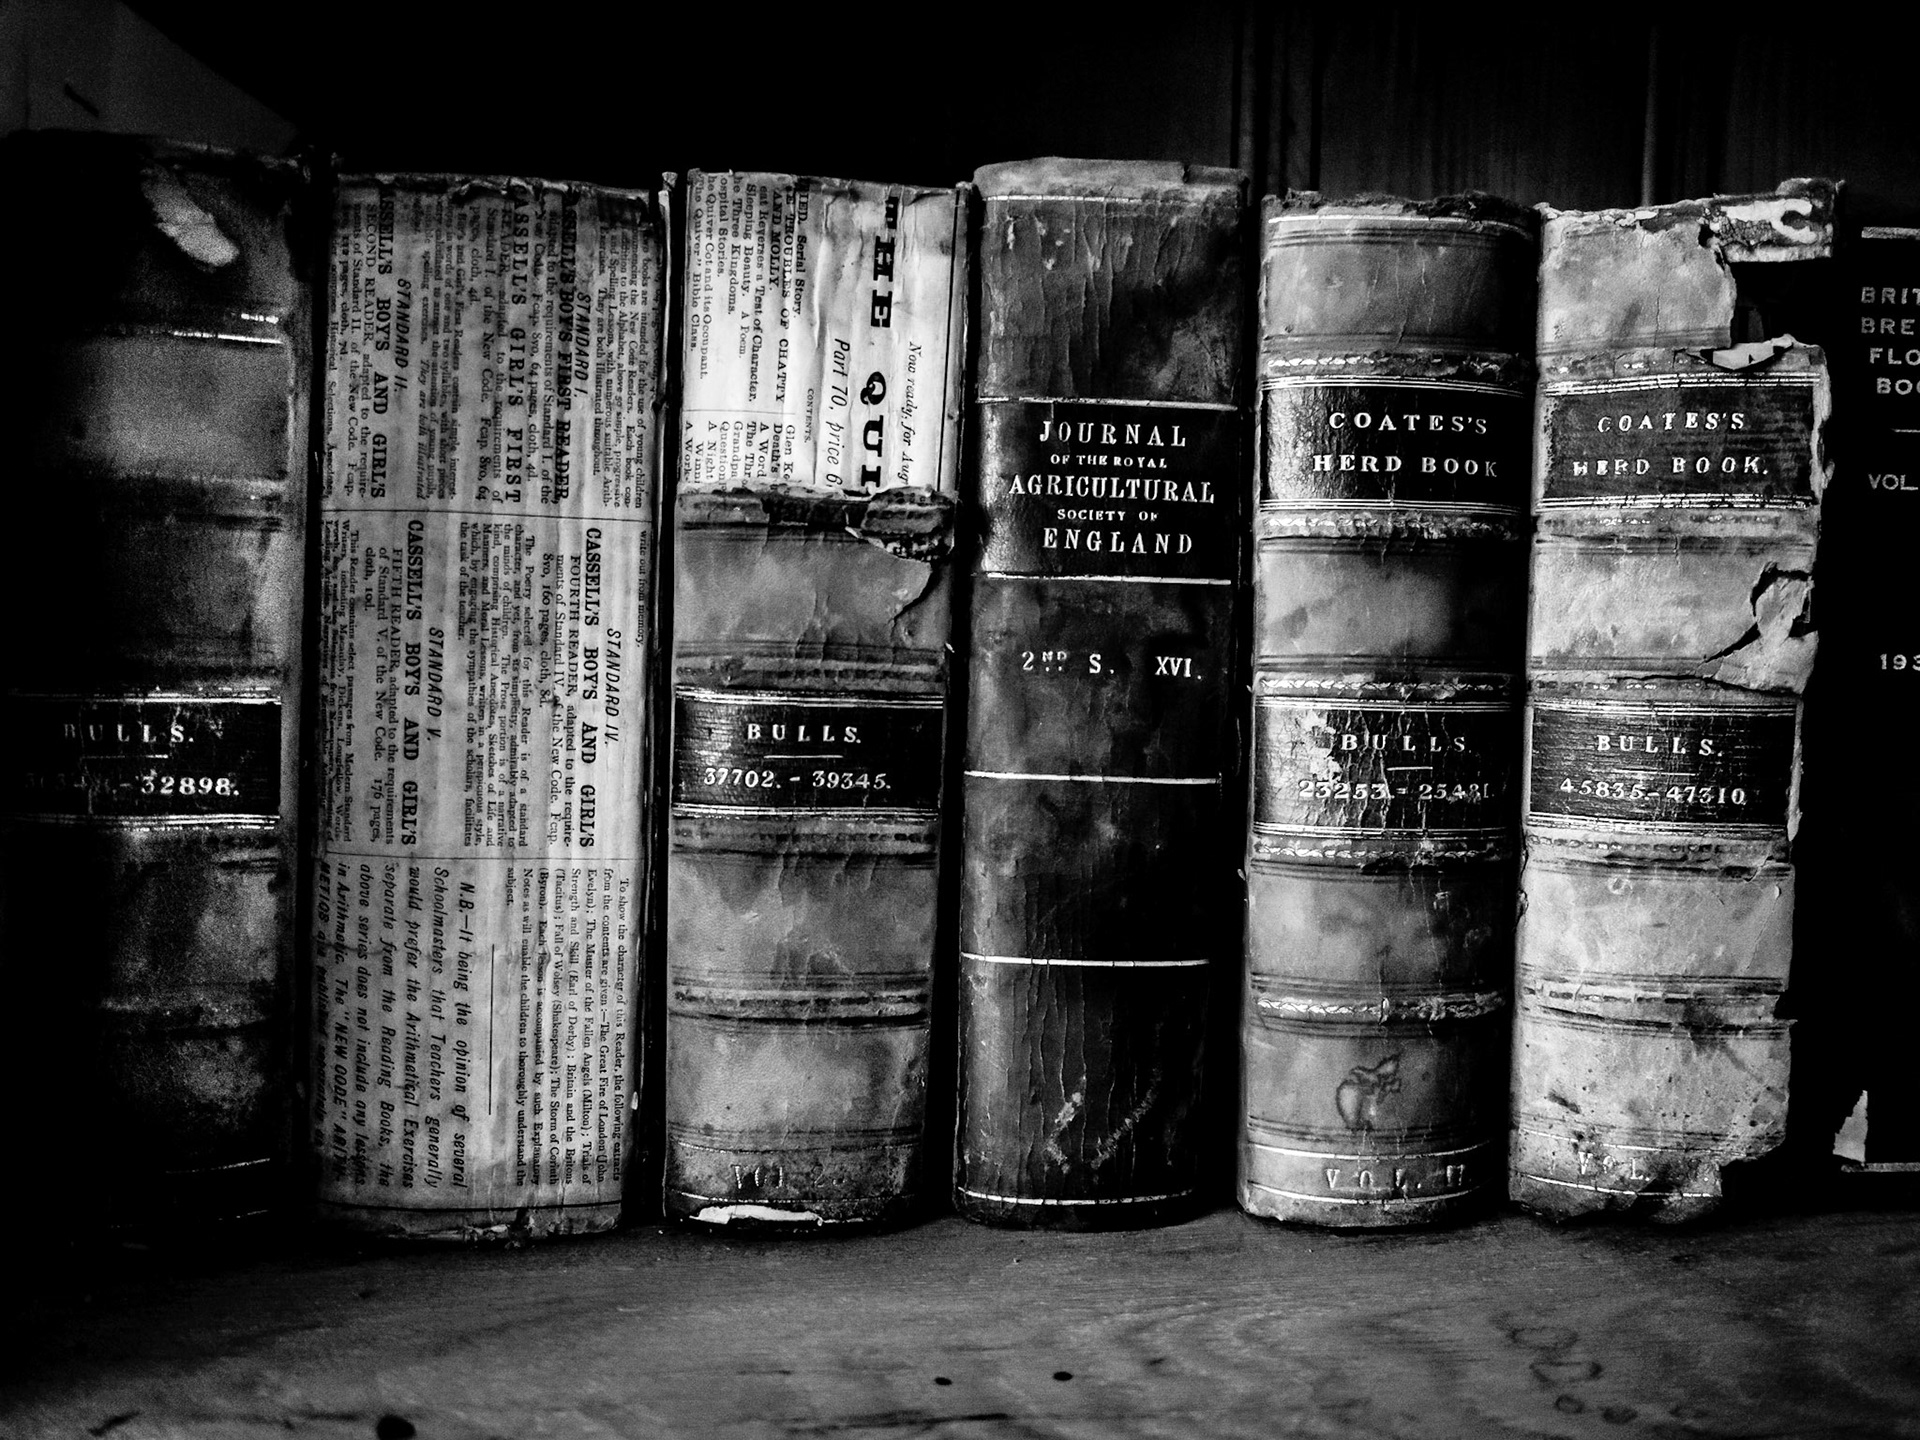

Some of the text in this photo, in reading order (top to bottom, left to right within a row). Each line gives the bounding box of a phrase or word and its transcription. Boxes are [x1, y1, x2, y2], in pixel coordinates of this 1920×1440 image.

[705, 194, 716, 240] Quiver
[732, 199, 742, 238] Three
[769, 191, 782, 291] AND MOLLY.
[704, 243, 713, 264] Cot
[717, 228, 728, 277] Stories.
[739, 184, 756, 358] Sleeping Beauty. A Poem.
[781, 213, 795, 298] TROUBLES
[795, 235, 807, 273] Serial
[871, 197, 899, 328] THE
[691, 272, 702, 307] Bible
[703, 268, 713, 292] and
[703, 296, 713, 312] its
[728, 244, 741, 315] Kingdoms.
[793, 279, 805, 318] Story.
[395, 278, 411, 368] STANDARD
[749, 210, 768, 402] Reverses Test of Character.
[779, 308, 789, 329] OF
[1860, 316, 1916, 336] BRE
[371, 186, 393, 498] ASSELL'S BOY'S AND GIRL'S
[551, 190, 579, 504] ASSELL'S BOY'S FIRST READER,
[575, 292, 590, 380] STANDARD
[690, 314, 700, 351] Class.
[699, 314, 711, 379] Occupant.
[508, 328, 526, 406] GIRL'S
[775, 338, 788, 402] CHATTY
[746, 421, 756, 447] The
[804, 388, 815, 443] CONTENTS.
[826, 338, 850, 488] Part 70, price 6
[899, 342, 921, 484] Now ready, for Aug
[1040, 421, 1185, 447] JOURNAL
[1329, 412, 1487, 434] COATES'S
[1598, 412, 1744, 433] COATES'S
[505, 428, 523, 502] FIRST
[706, 421, 717, 479] A Night
[757, 422, 769, 478] A Word
[771, 423, 783, 473] Death's
[784, 425, 795, 455] Glen
[1051, 454, 1167, 468] OF THE ROYAL
[1009, 474, 1214, 504] AGRICULTURAL
[1313, 455, 1497, 478] HERD BOOK
[1573, 456, 1769, 476] HERD BOOK.
[1043, 528, 1192, 554] ENGLAND
[1057, 509, 1159, 522] SOCIETY OF
[389, 548, 403, 672] FIFTH READER,
[402, 520, 423, 845] CASSELL'S BOY'S AND GIRL'S
[427, 627, 444, 741] STANDARD V.
[580, 528, 601, 847] CASSELL'S BOY'S AND GIRL'S
[605, 628, 621, 745] STANDARD IV.
[1089, 654, 1115, 674] S.
[1155, 656, 1202, 680] XVI.
[562, 555, 581, 847] FOURTH READER, adapted to the require-
[747, 723, 861, 744] BULLS.
[1340, 734, 1472, 753] BULLS.
[1596, 734, 1722, 757] BULLS.
[453, 951, 472, 991] being
[378, 865, 397, 1187] separate from the Reading Books, the
[403, 867, 423, 1188] would prefer the Arithmetical Exercises
[424, 867, 449, 1188] Schoolmasters that Teachers generally
[455, 1003, 471, 1025] the
[612, 878, 629, 1181] To show the character of this Reader, the following extracts
[453, 1040, 470, 1093] opinion
[452, 1105, 469, 1122] of
[453, 1133, 468, 1188] several
